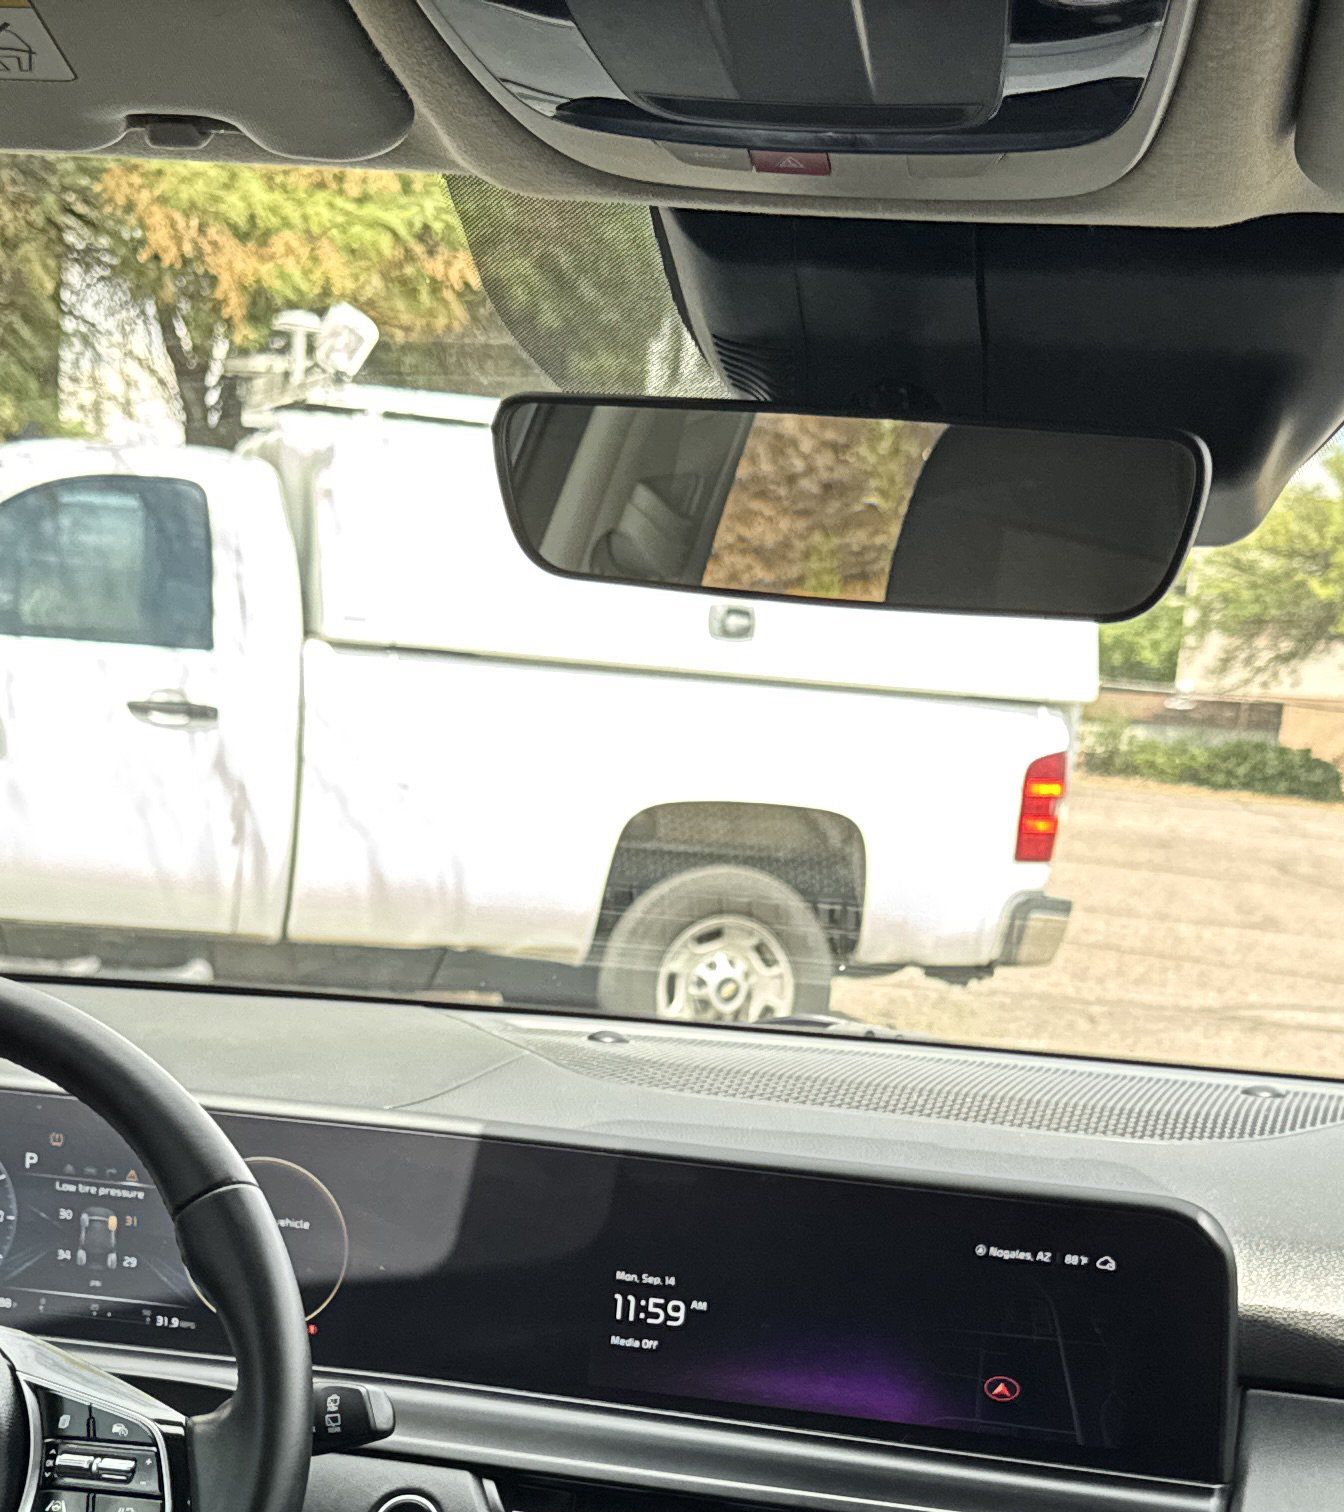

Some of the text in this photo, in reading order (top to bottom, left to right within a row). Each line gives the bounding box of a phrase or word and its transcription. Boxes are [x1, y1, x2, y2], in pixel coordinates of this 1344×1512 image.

[24, 1152, 38, 1168] P
[55, 1181, 145, 1200] Low tire pressure
[59, 1208, 73, 1220] 30
[125, 1216, 138, 1227] 31
[122, 1256, 138, 1268] 29
[1036, 1251, 1052, 1263] AZ
[664, 1276, 676, 1286] 14
[614, 1293, 708, 1327] 11:59 AM
[155, 1315, 179, 1328] 31.9
[610, 1335, 659, 1350] Media Off
